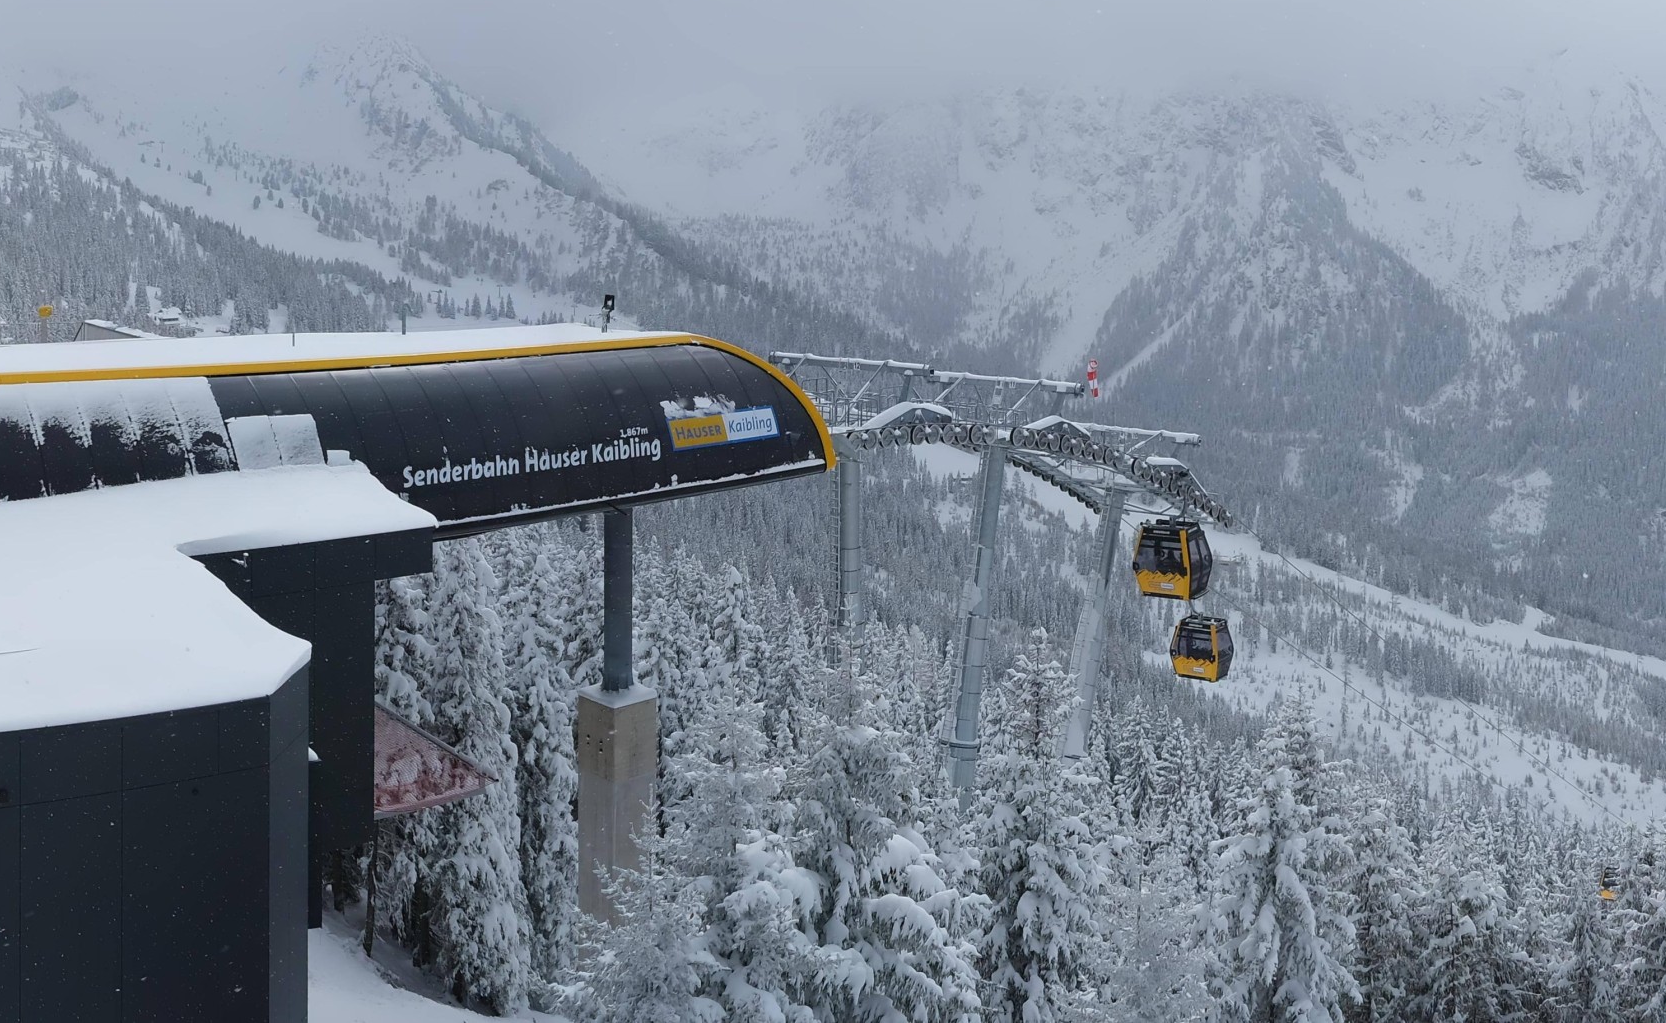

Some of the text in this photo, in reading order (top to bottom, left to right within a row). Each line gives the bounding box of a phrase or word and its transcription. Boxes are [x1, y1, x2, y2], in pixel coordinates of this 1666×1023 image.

[620, 426, 649, 438] 1.867m
[675, 417, 772, 441] HAUSER Kaibling
[402, 436, 662, 489] Senderbahn Hauser Kaibling
